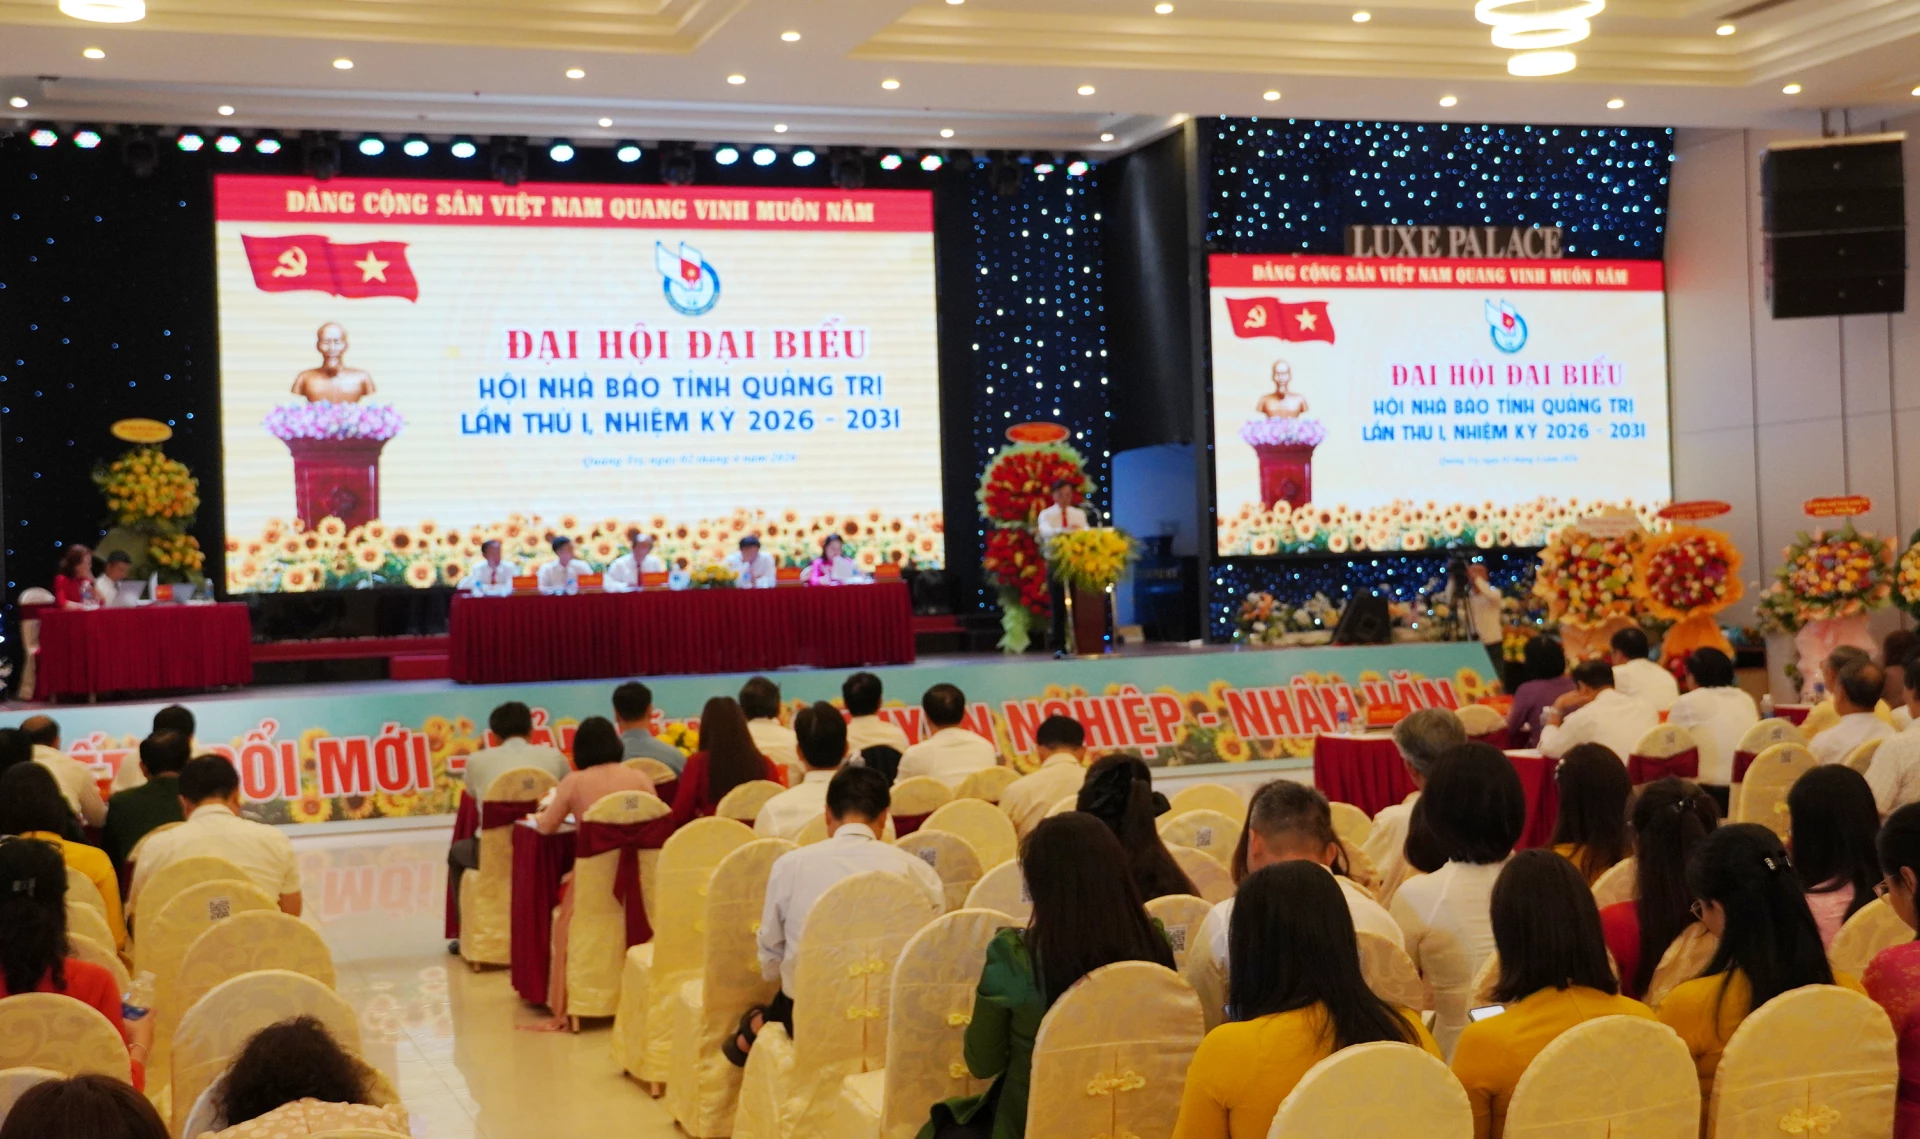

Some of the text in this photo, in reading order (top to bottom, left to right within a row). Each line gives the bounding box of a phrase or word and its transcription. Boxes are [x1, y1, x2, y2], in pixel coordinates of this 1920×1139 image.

[286, 186, 874, 222] ĐẢNG CỘNG SẢN VIỆT NAM QUANG VINH MUÔN NĂM
[1352, 225, 1564, 260] LUXE PALACE
[1300, 262, 1342, 284] CỘNG
[1380, 263, 1416, 285] VIỆT
[1419, 266, 1452, 283] NAM
[1456, 267, 1507, 285] QUANG
[1509, 267, 1547, 284] VINH
[1550, 265, 1593, 285] MUÔN
[1595, 266, 1629, 285] NĂM
[507, 317, 866, 365] ĐẠI HỘI ĐẠI BIỂU
[479, 372, 526, 404] HỘI
[539, 373, 594, 398] NHÀ
[606, 373, 660, 398] BÁO
[1450, 358, 1494, 389] HỘI
[606, 408, 688, 438] NHIỆM
[749, 411, 814, 430] 2026
[847, 408, 899, 429] 2031
[1546, 423, 1589, 439] 2026
[1610, 423, 1645, 438] 2031
[1227, 677, 1358, 738] NHÂN
[318, 724, 431, 796] MỚI
